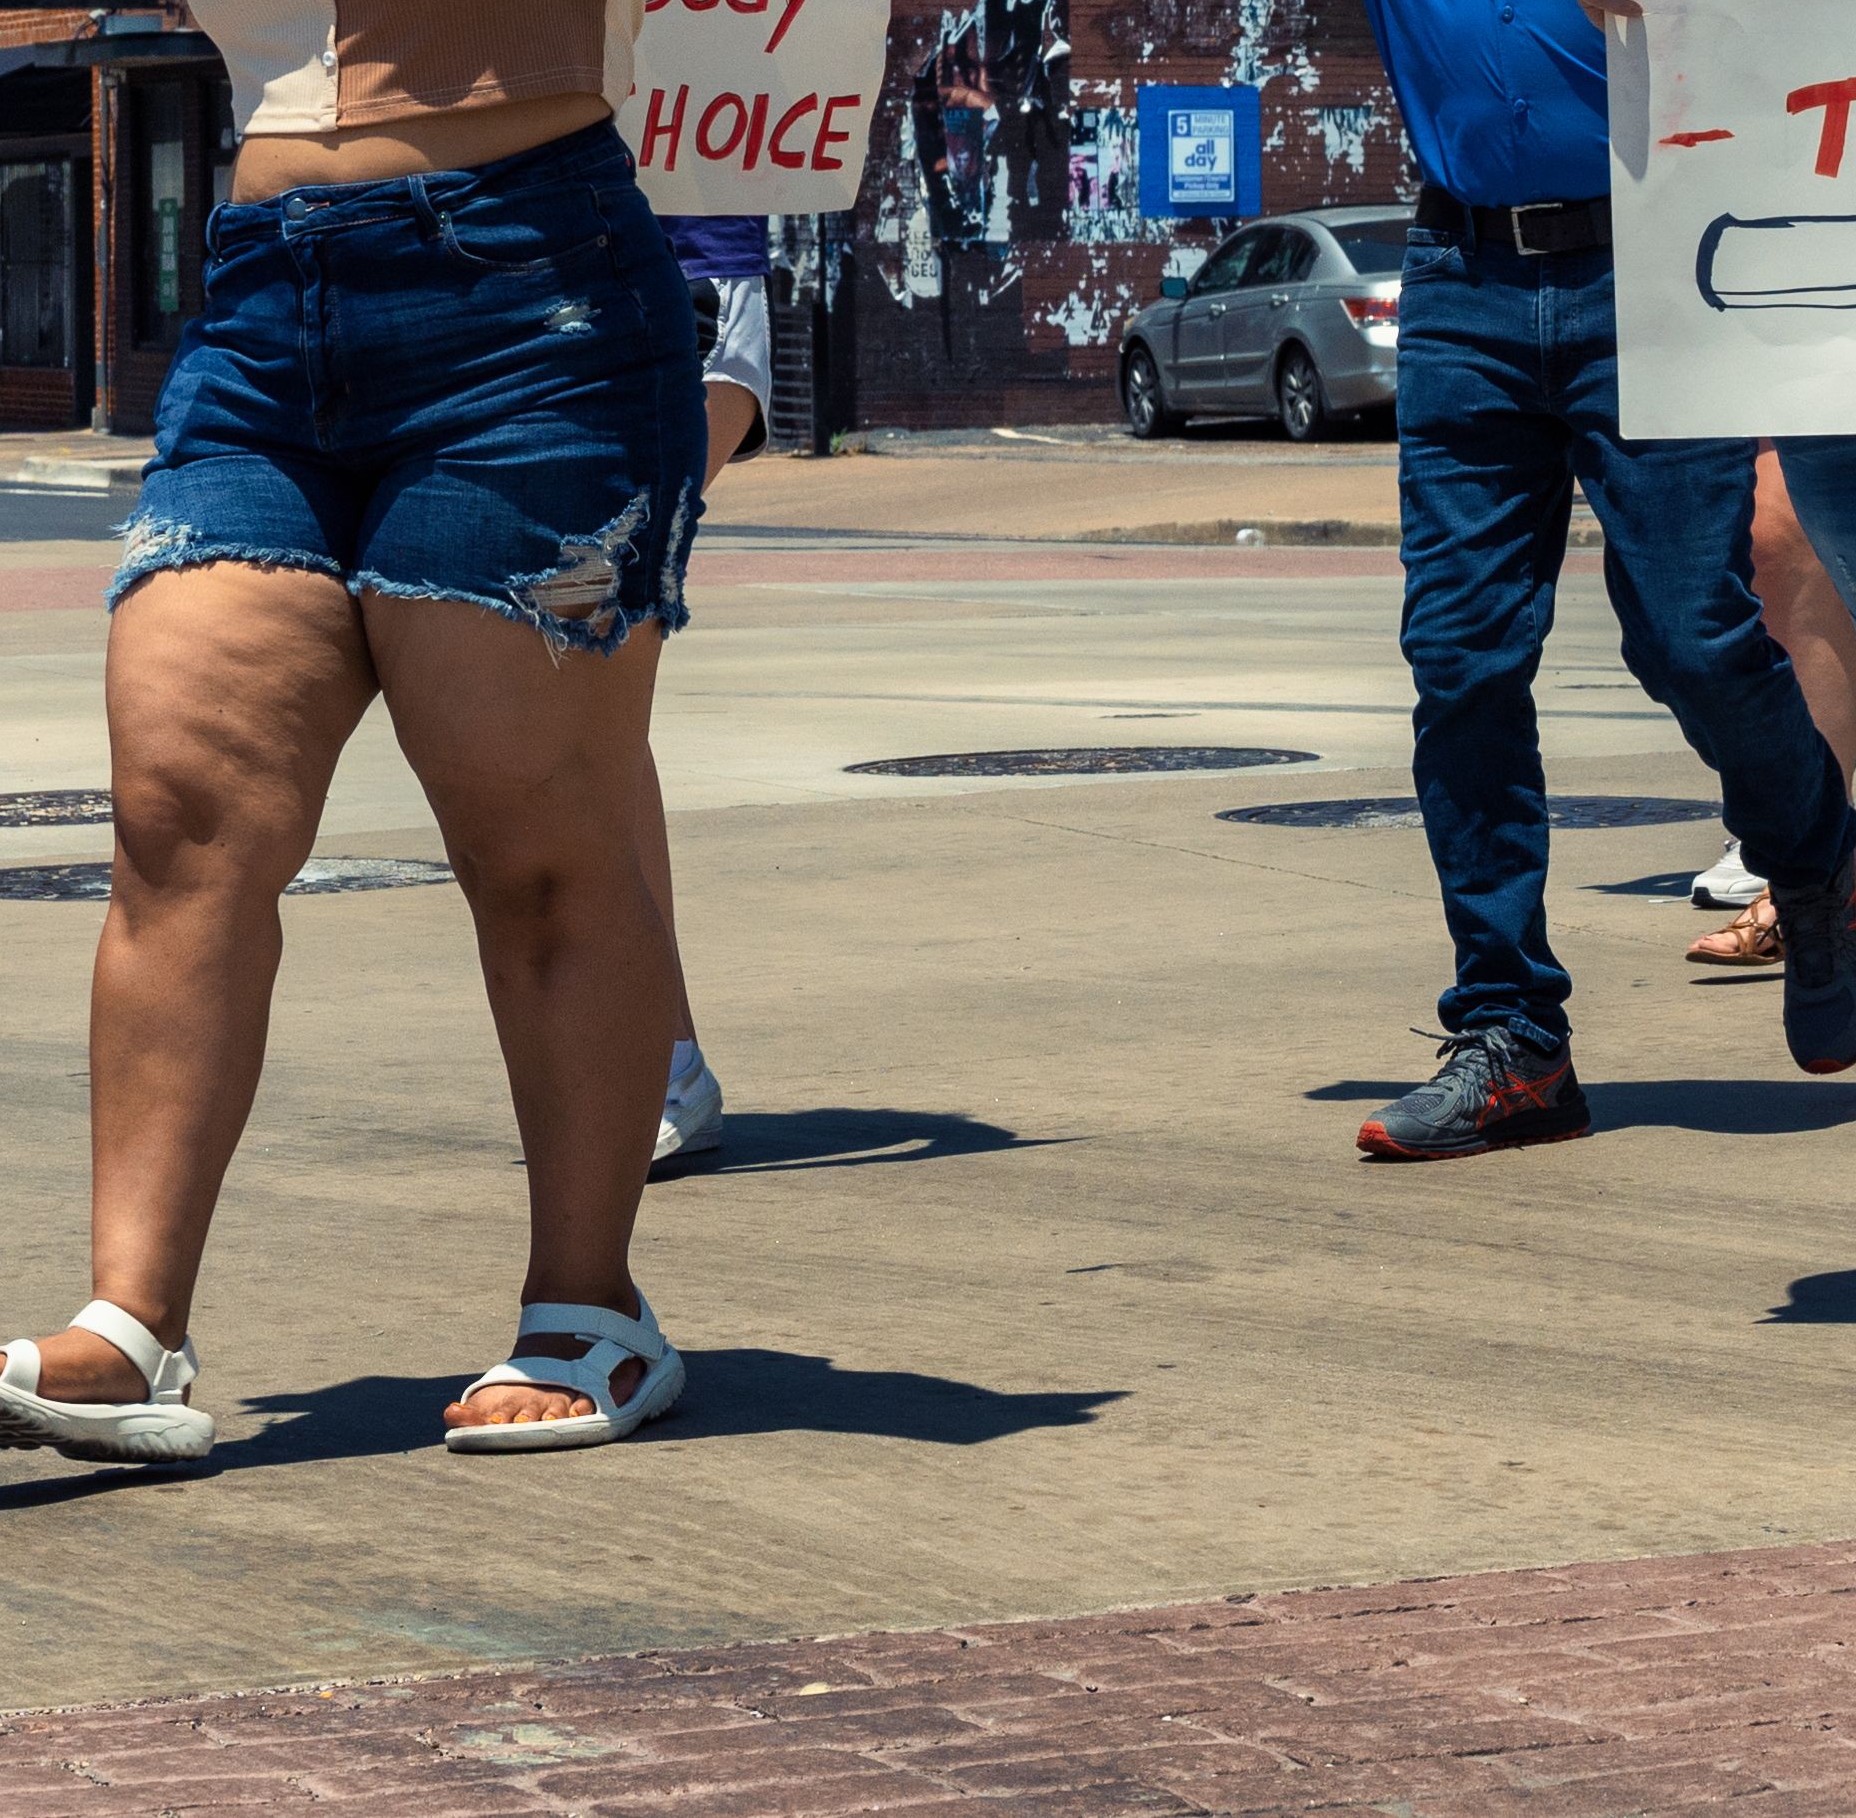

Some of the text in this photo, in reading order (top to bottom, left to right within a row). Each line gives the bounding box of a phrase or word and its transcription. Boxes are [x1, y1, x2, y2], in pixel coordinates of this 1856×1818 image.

[628, 84, 861, 172] HOICE
[1176, 116, 1188, 135] 5
[1195, 139, 1215, 155] all
[1184, 153, 1218, 172] day
